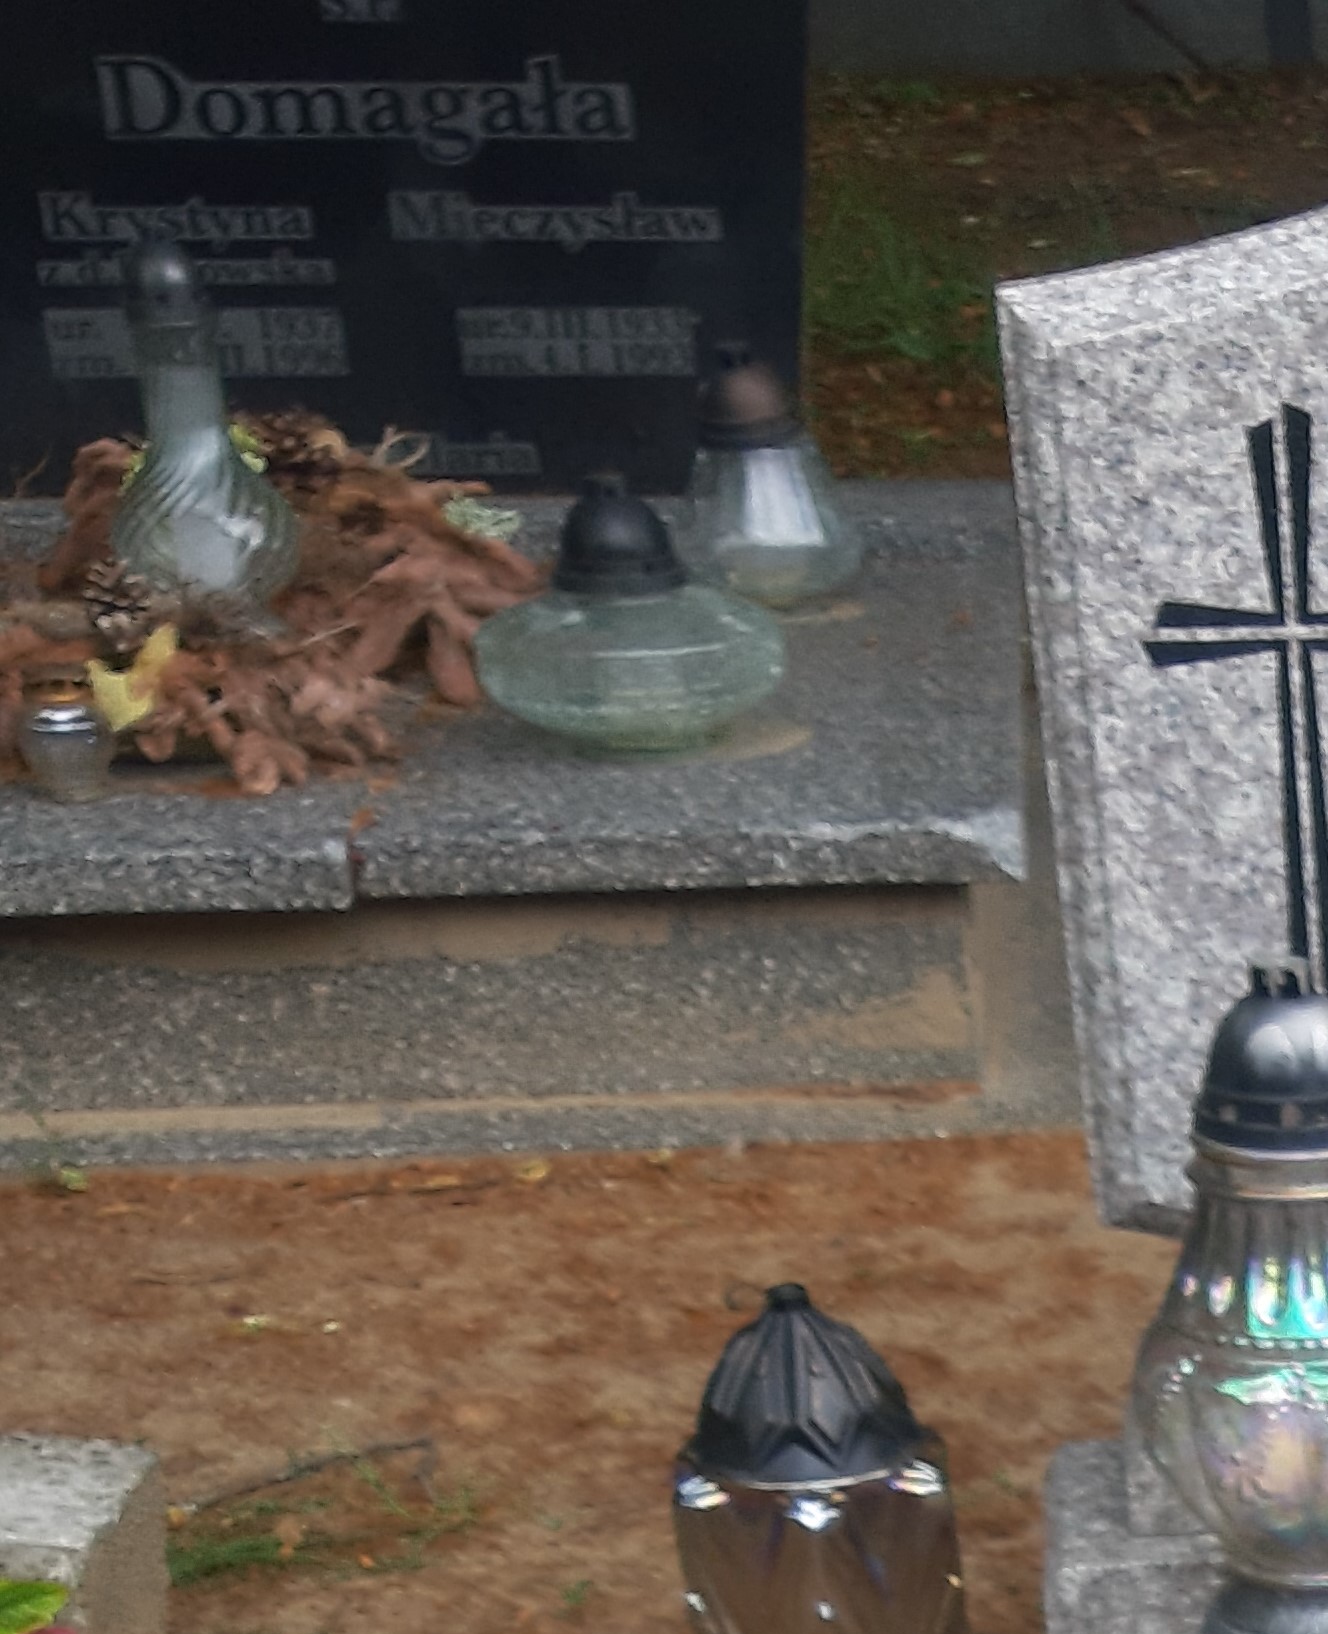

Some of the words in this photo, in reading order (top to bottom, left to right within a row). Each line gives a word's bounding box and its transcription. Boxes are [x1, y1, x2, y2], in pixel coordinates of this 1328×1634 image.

[100, 58, 634, 163] Domagała
[44, 195, 312, 247] Krystyna
[393, 194, 720, 250] Mieczysław
